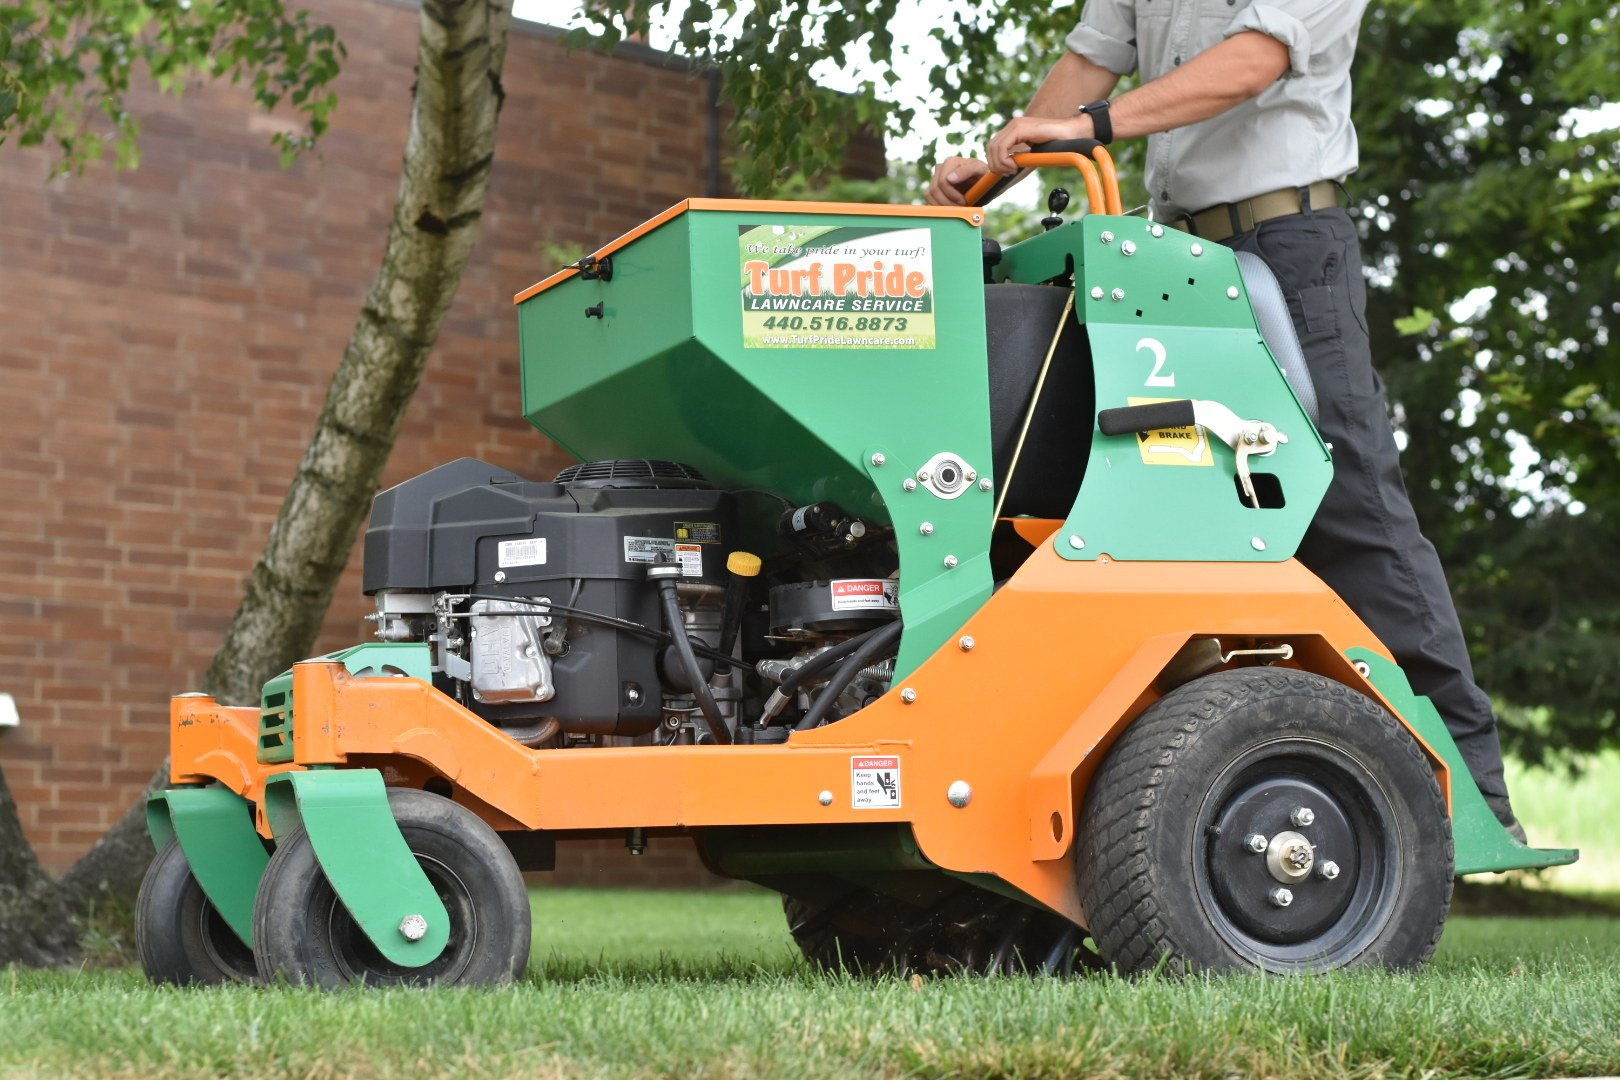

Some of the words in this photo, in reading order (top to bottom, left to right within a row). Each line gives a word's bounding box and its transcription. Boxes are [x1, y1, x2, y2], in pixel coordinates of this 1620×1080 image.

[747, 243, 769, 254] We
[805, 245, 840, 257] pride
[844, 246, 857, 255] in
[859, 248, 892, 259] your
[895, 246, 926, 259] turf!
[744, 260, 823, 296] Turf
[833, 260, 926, 297] Pride
[750, 299, 846, 311] LAWNCARE
[851, 299, 924, 312] SERVICE
[763, 316, 908, 331] 440.516.8873
[762, 335, 916, 346] www.TurfPrideLawncare.com
[1135, 337, 1176, 387] 2
[1158, 431, 1192, 439] BRAKE
